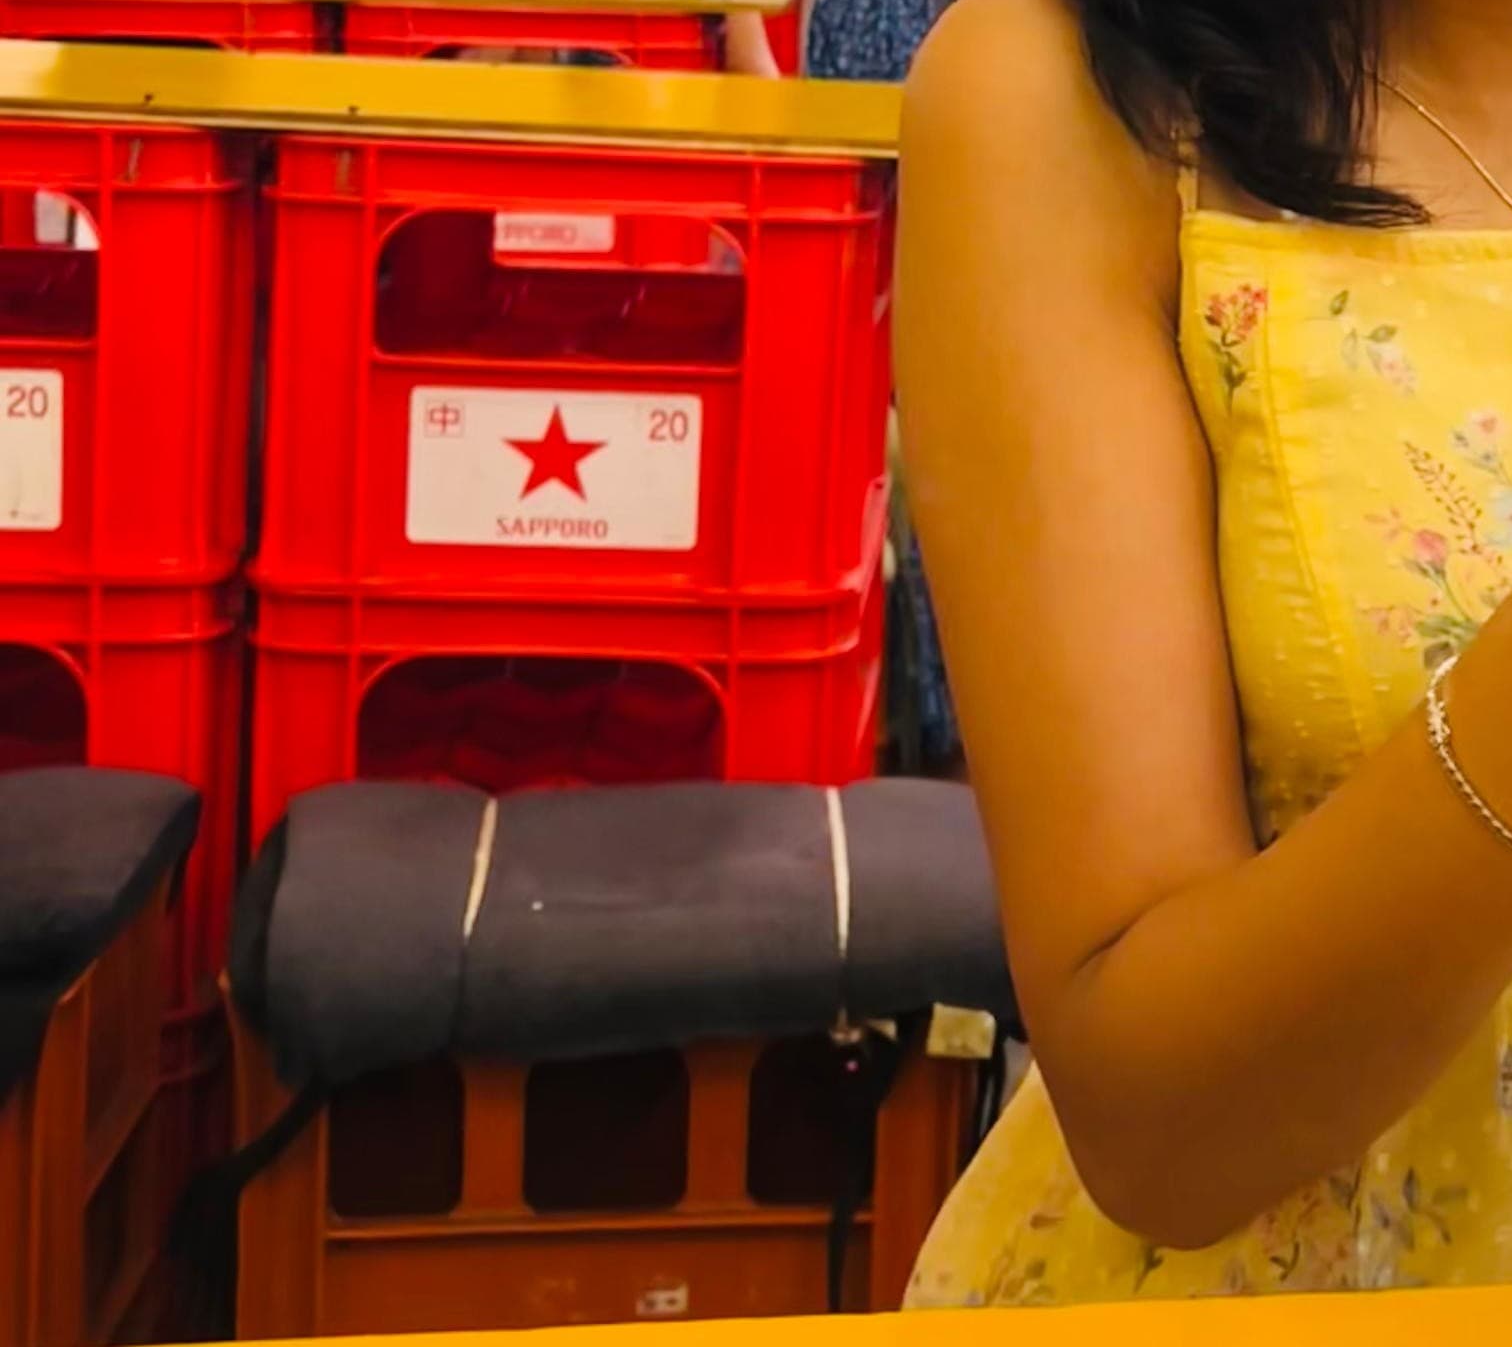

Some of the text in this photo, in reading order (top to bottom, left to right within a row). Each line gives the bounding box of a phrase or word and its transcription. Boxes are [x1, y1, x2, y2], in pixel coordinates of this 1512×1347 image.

[6, 385, 49, 419] 20
[428, 401, 461, 434] 中
[648, 409, 690, 442] 20
[496, 517, 609, 538] SAPPORO
